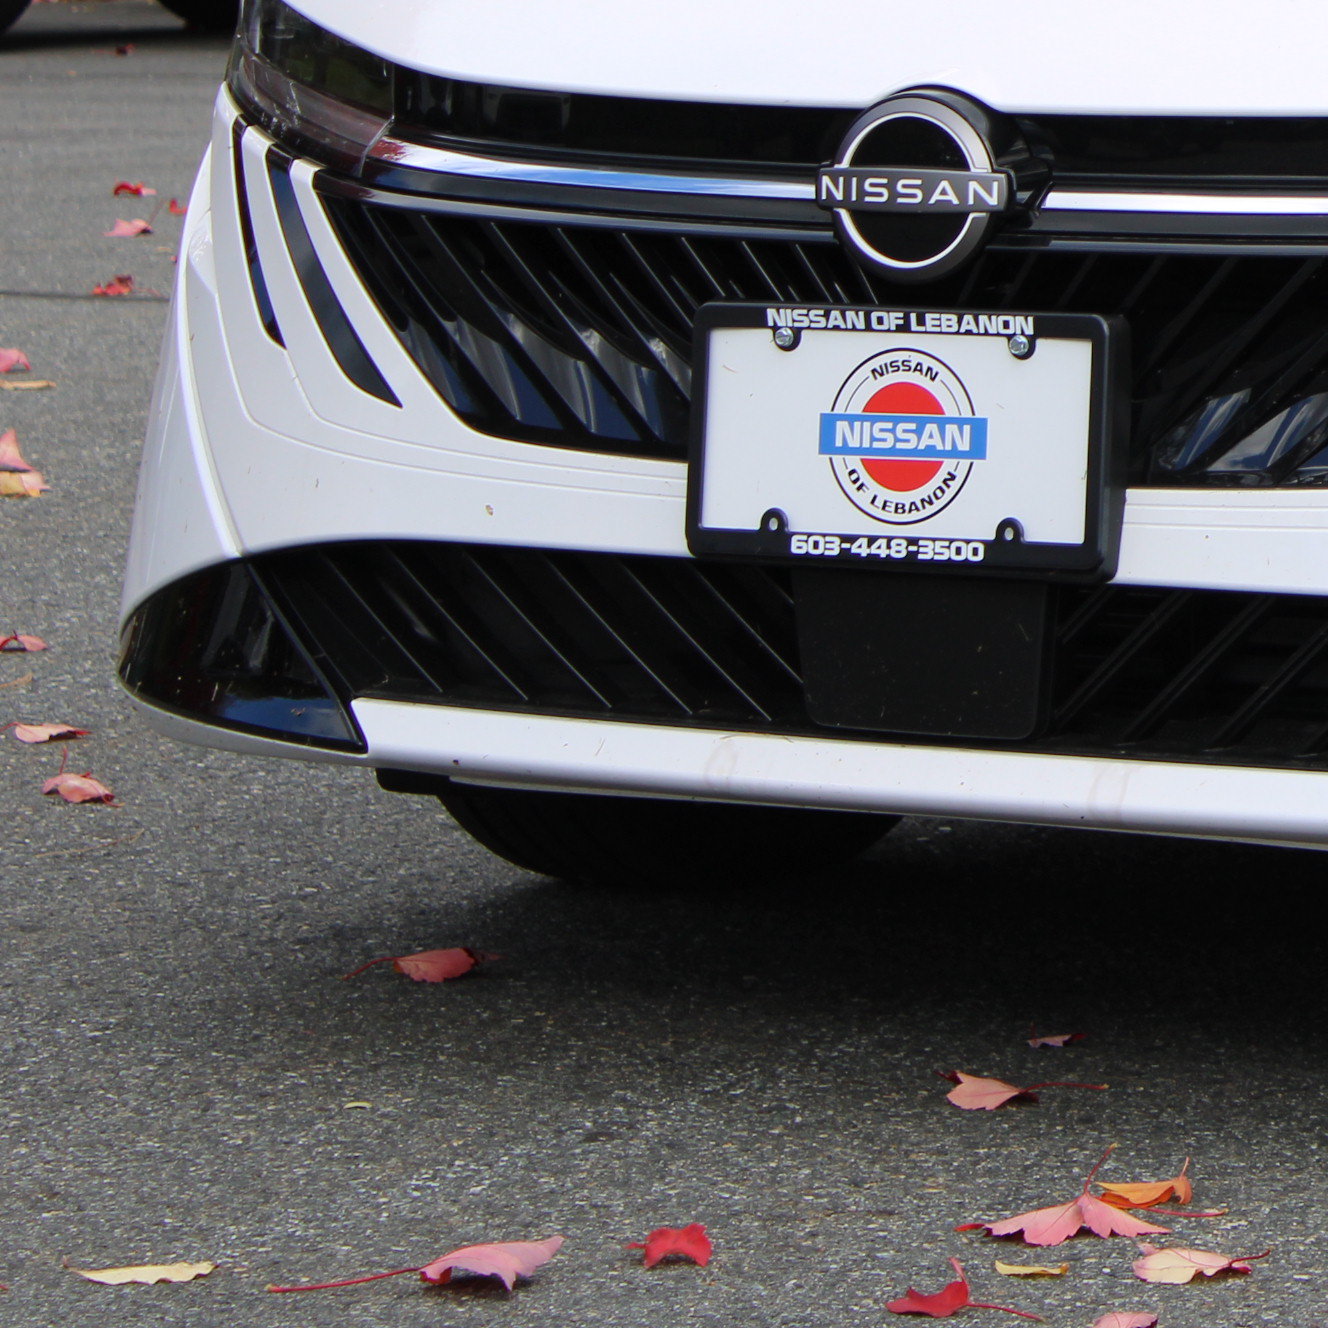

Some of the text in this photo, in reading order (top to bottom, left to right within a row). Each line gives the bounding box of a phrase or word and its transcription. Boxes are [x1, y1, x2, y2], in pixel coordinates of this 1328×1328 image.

[820, 175, 999, 205] NISSAN
[766, 307, 1035, 337] NISSAN OF LEBANON
[871, 359, 939, 382] NISSAN
[835, 420, 970, 451] NISSAN
[847, 467, 958, 516] OF LEBANON
[790, 535, 984, 562] 603-448-3500
